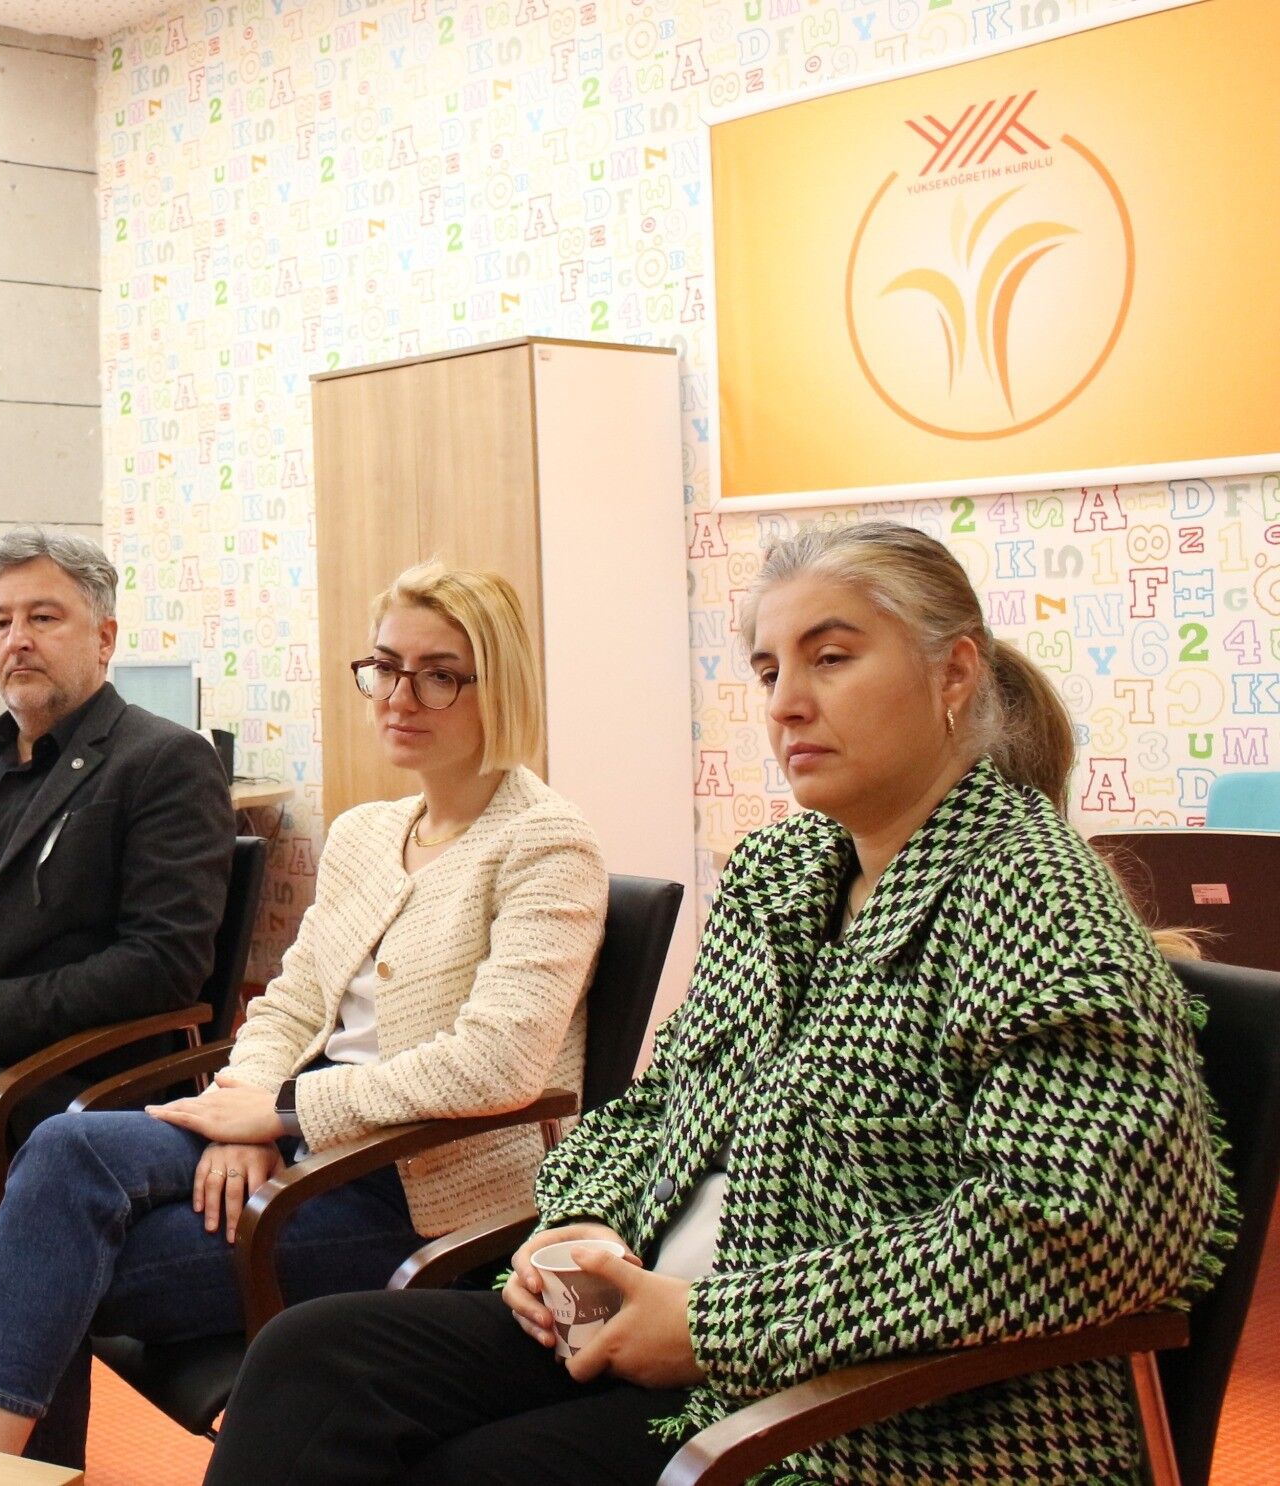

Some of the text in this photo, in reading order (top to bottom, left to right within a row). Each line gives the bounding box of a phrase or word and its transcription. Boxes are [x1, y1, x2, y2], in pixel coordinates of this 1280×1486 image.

[659, 20, 675, 39] B
[776, 26, 794, 55] F
[852, 12, 876, 40] Y
[551, 39, 574, 83] F
[672, 38, 709, 91] A
[737, 28, 770, 65] D
[582, 77, 600, 108] 2
[609, 66, 631, 102] 4
[528, 109, 543, 131] Y
[615, 103, 644, 140] K
[590, 160, 604, 181] U
[611, 147, 638, 181] M
[1005, 155, 1053, 176] KURULU
[583, 188, 611, 221] D
[617, 189, 632, 214] F
[683, 182, 700, 206] Y
[618, 270, 633, 286] G
[670, 251, 684, 270] B
[560, 260, 583, 302] F
[591, 301, 608, 331] 2
[619, 293, 641, 328] 4
[950, 496, 975, 532] 2
[987, 493, 1019, 533] 4
[1169, 479, 1215, 519] D
[1224, 483, 1250, 517] F
[689, 512, 728, 558] A
[995, 540, 1036, 578] K
[989, 590, 1025, 625] M
[1129, 567, 1168, 618] F
[1224, 588, 1248, 611] G
[689, 612, 725, 648] N
[1074, 594, 1124, 637] N
[1088, 646, 1117, 675] Y
[1132, 621, 1169, 676] 6
[1178, 623, 1208, 662] 2
[1223, 620, 1261, 665] 4
[700, 656, 719, 679] Y
[702, 708, 728, 746] 3
[735, 728, 759, 762] 3
[1090, 708, 1128, 753] 3
[1138, 732, 1169, 771] 3
[1188, 733, 1214, 759] U
[1223, 728, 1268, 765] M
[695, 751, 734, 796] A
[1082, 758, 1135, 812] A
